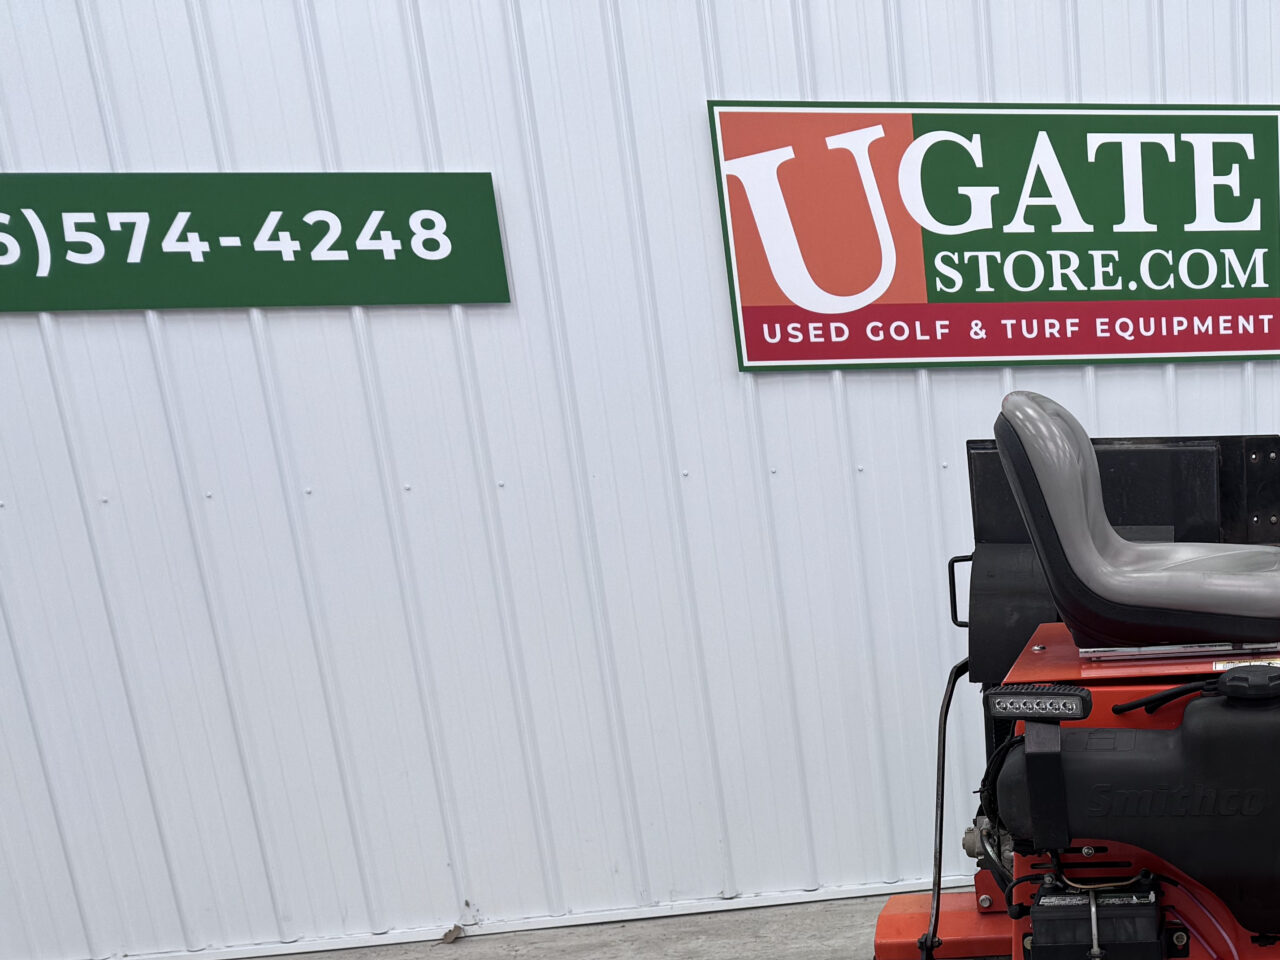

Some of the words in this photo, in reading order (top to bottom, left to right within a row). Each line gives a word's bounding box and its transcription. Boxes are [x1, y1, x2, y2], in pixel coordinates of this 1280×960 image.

[934, 247, 1270, 293] STORE.COM
[763, 322, 850, 343] USED
[866, 320, 950, 341] GOLF
[969, 320, 988, 340] &
[1001, 318, 1081, 339] TURF
[1095, 314, 1275, 341] EQUIPMENT
